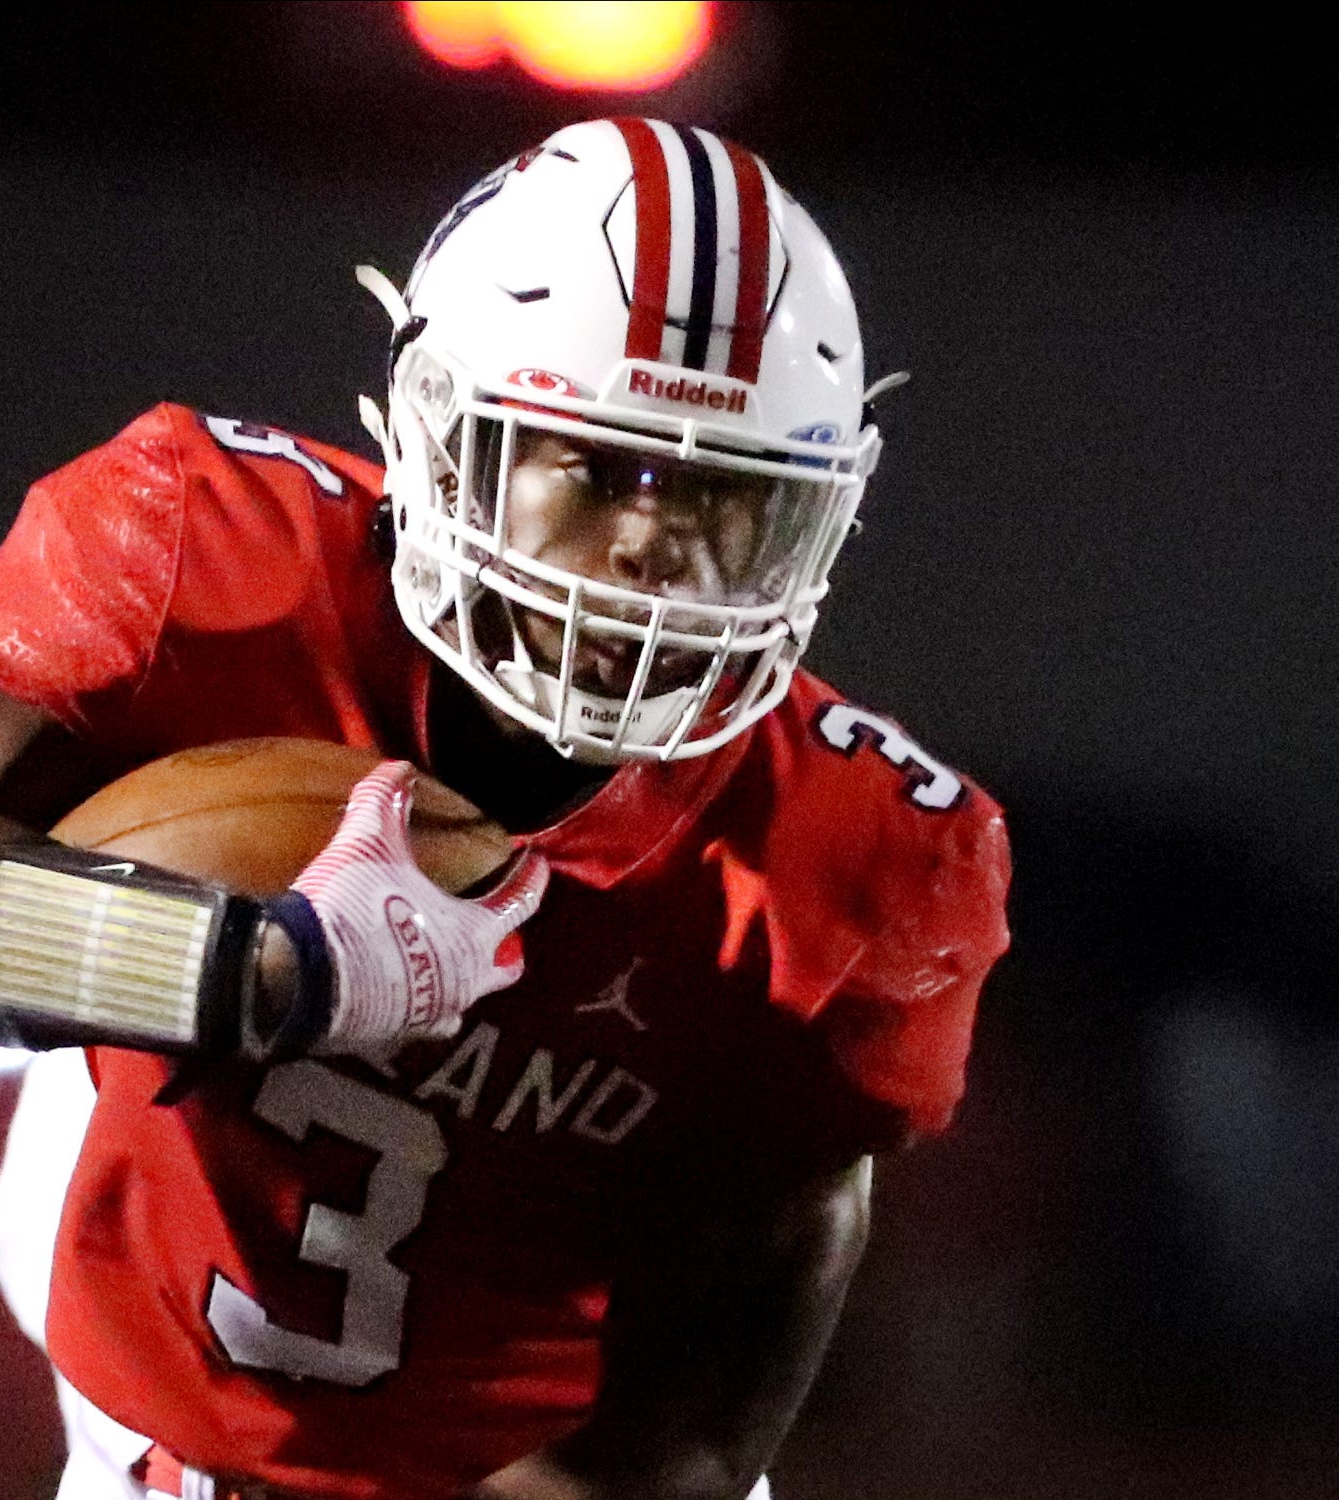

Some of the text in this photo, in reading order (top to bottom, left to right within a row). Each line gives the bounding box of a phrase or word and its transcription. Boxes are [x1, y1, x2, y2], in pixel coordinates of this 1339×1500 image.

[628, 367, 747, 414] Riddell
[581, 706, 642, 723] Riddll
[818, 702, 963, 811] 3
[395, 917, 437, 1026] BATT
[414, 1022, 659, 1145] AND
[206, 1058, 450, 1387] 3
